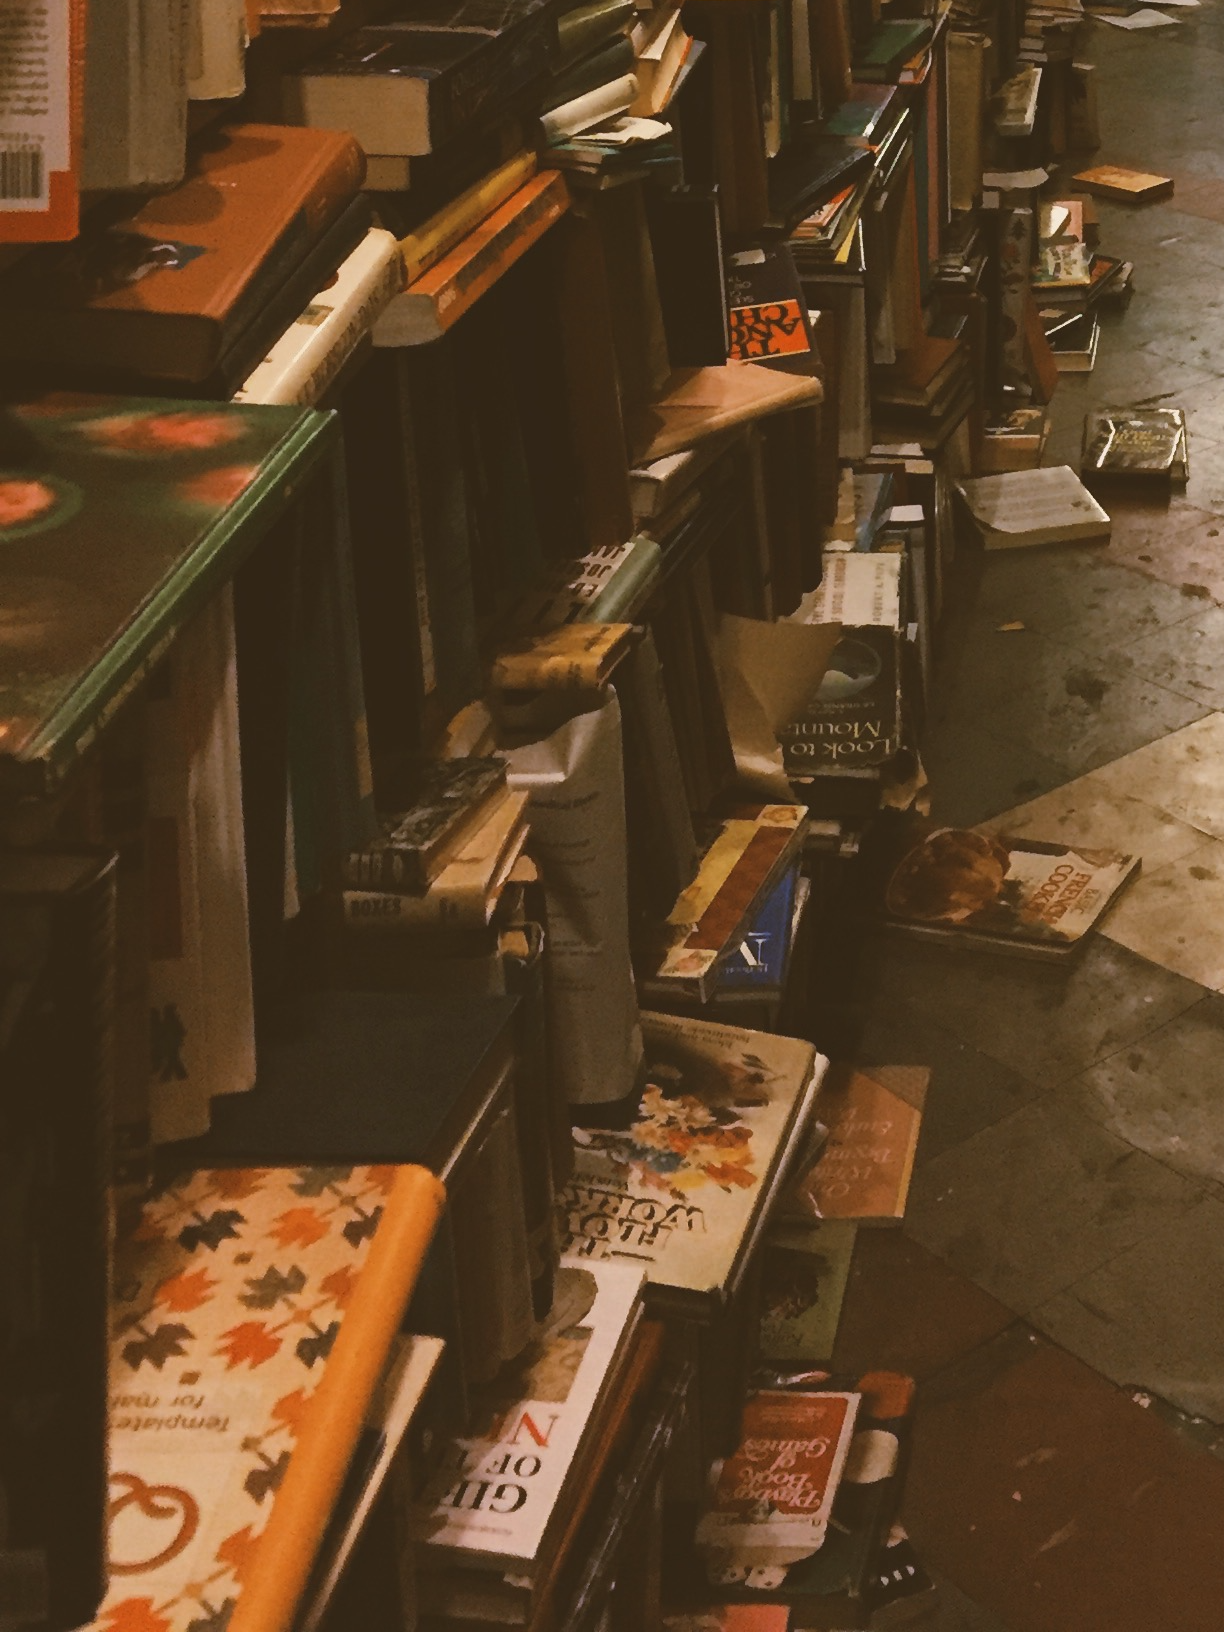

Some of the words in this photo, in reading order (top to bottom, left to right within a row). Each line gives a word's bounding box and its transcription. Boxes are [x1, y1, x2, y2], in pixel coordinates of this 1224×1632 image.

[786, 720, 881, 740] Mount
[790, 741, 815, 757] to
[823, 738, 891, 759] Look
[168, 1394, 205, 1410] for
[107, 1414, 230, 1433] Template
[742, 1437, 831, 1462] Games
[768, 1448, 796, 1472] of
[485, 1453, 542, 1478] OF
[738, 1467, 813, 1491] Book
